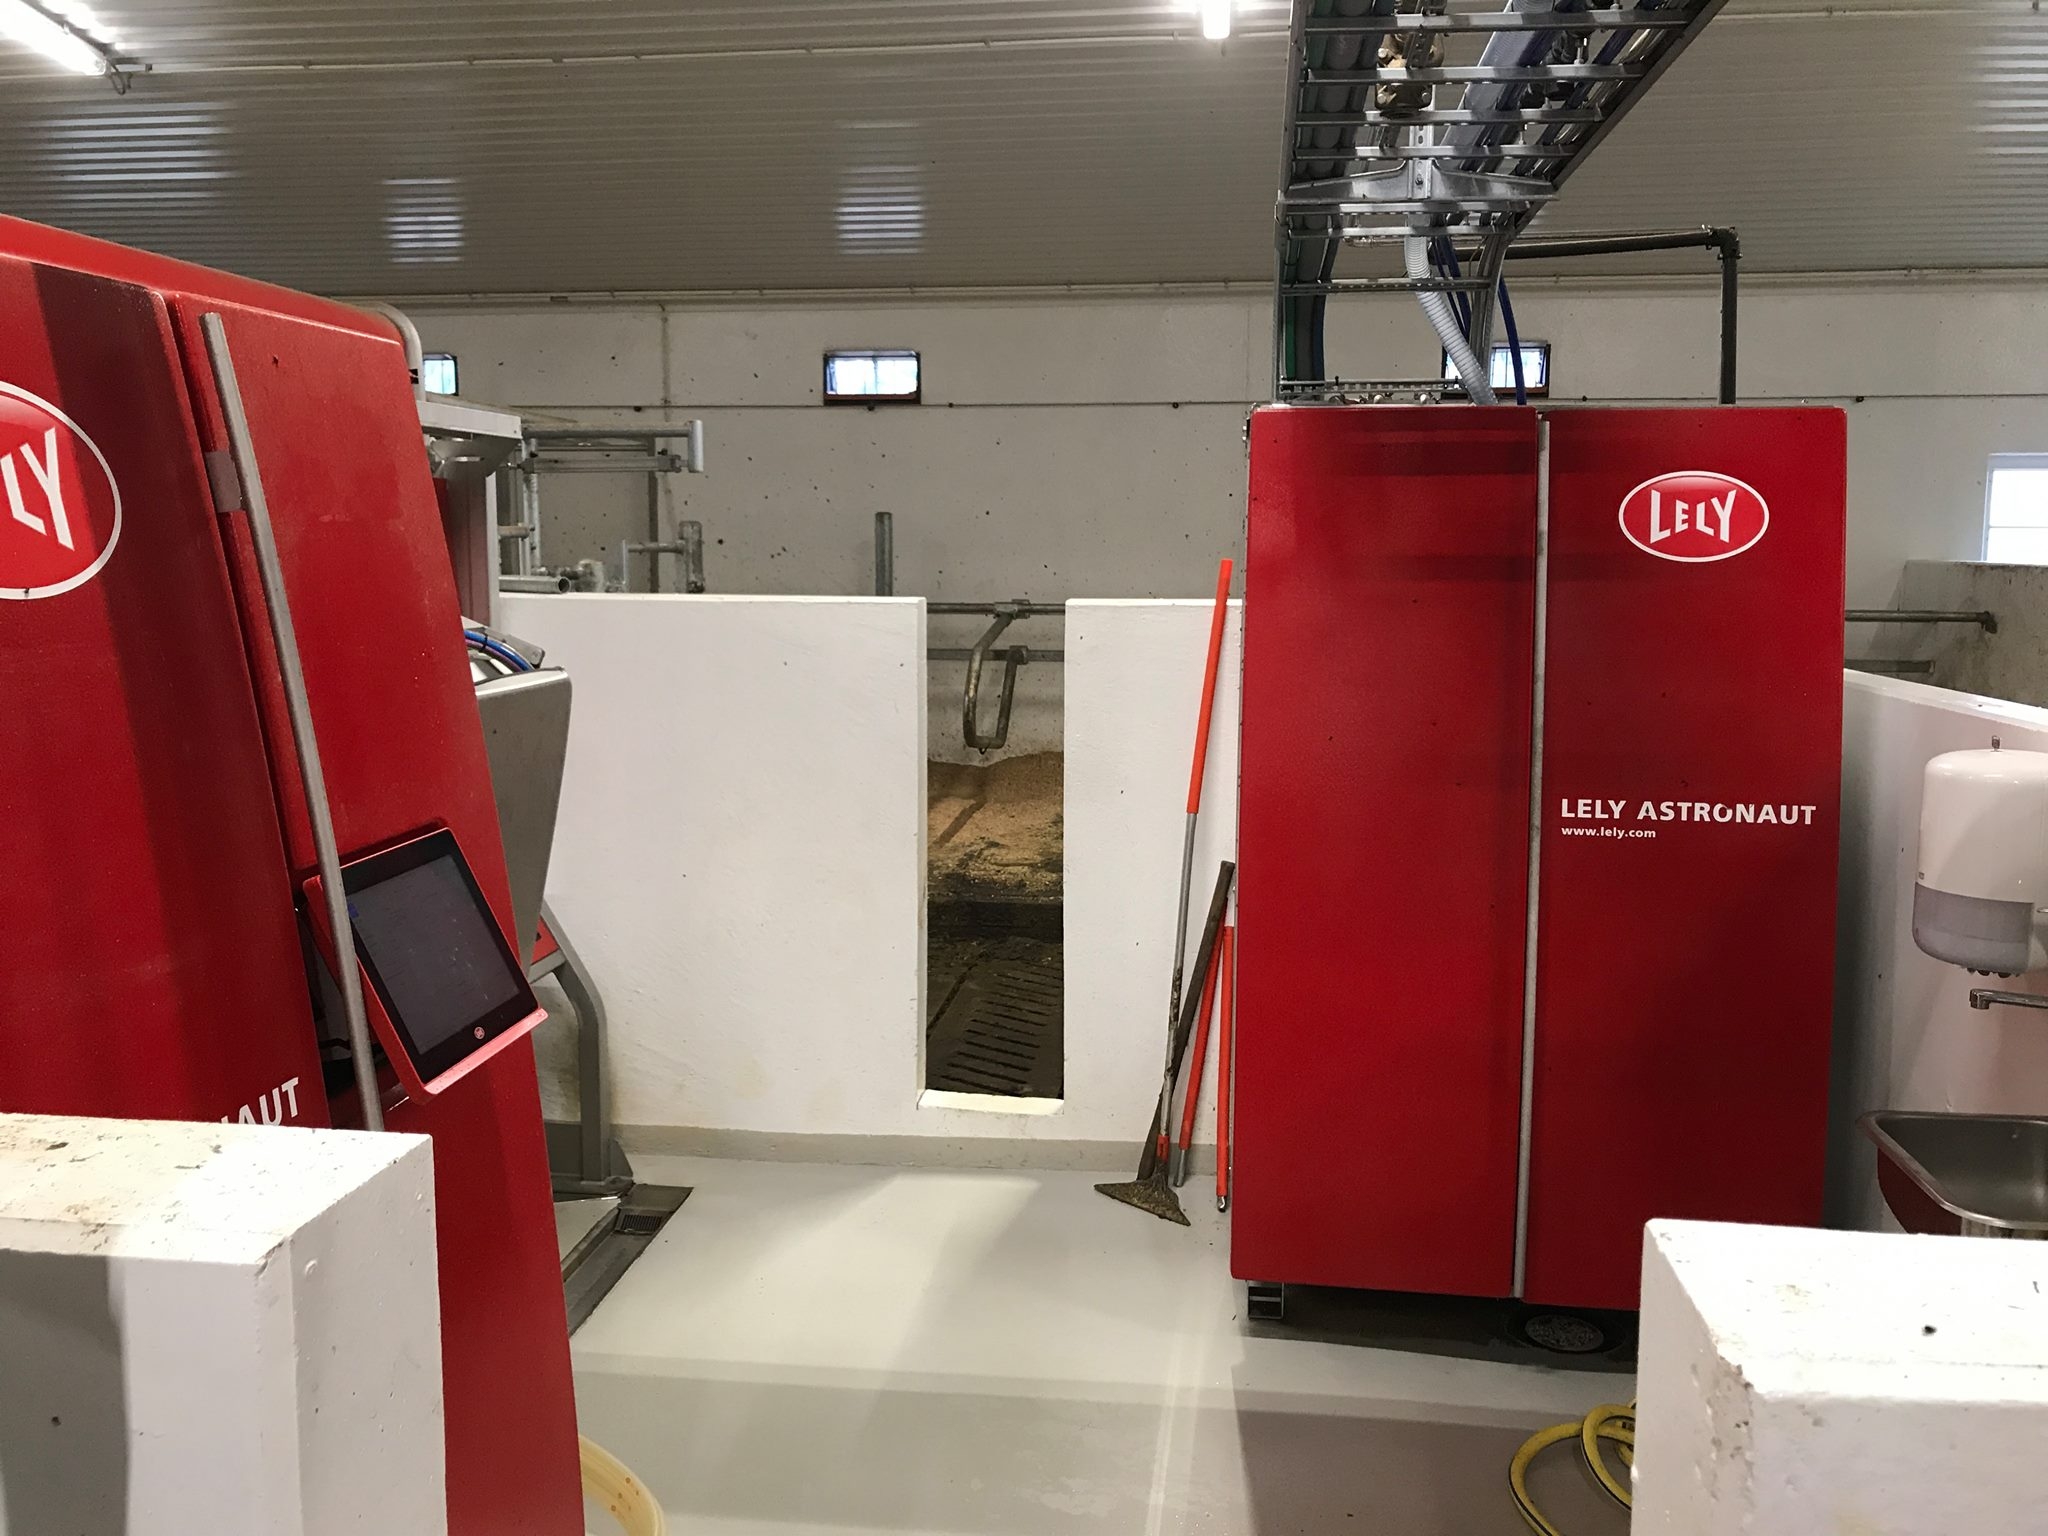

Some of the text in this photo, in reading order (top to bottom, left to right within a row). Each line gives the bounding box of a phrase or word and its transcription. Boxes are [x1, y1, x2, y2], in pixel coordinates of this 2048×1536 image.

[0, 427, 75, 552] LY
[1650, 489, 1737, 544] LELY
[1561, 799, 1817, 825] LELY ASTRONAUT
[1561, 827, 1656, 839] www.lely.com
